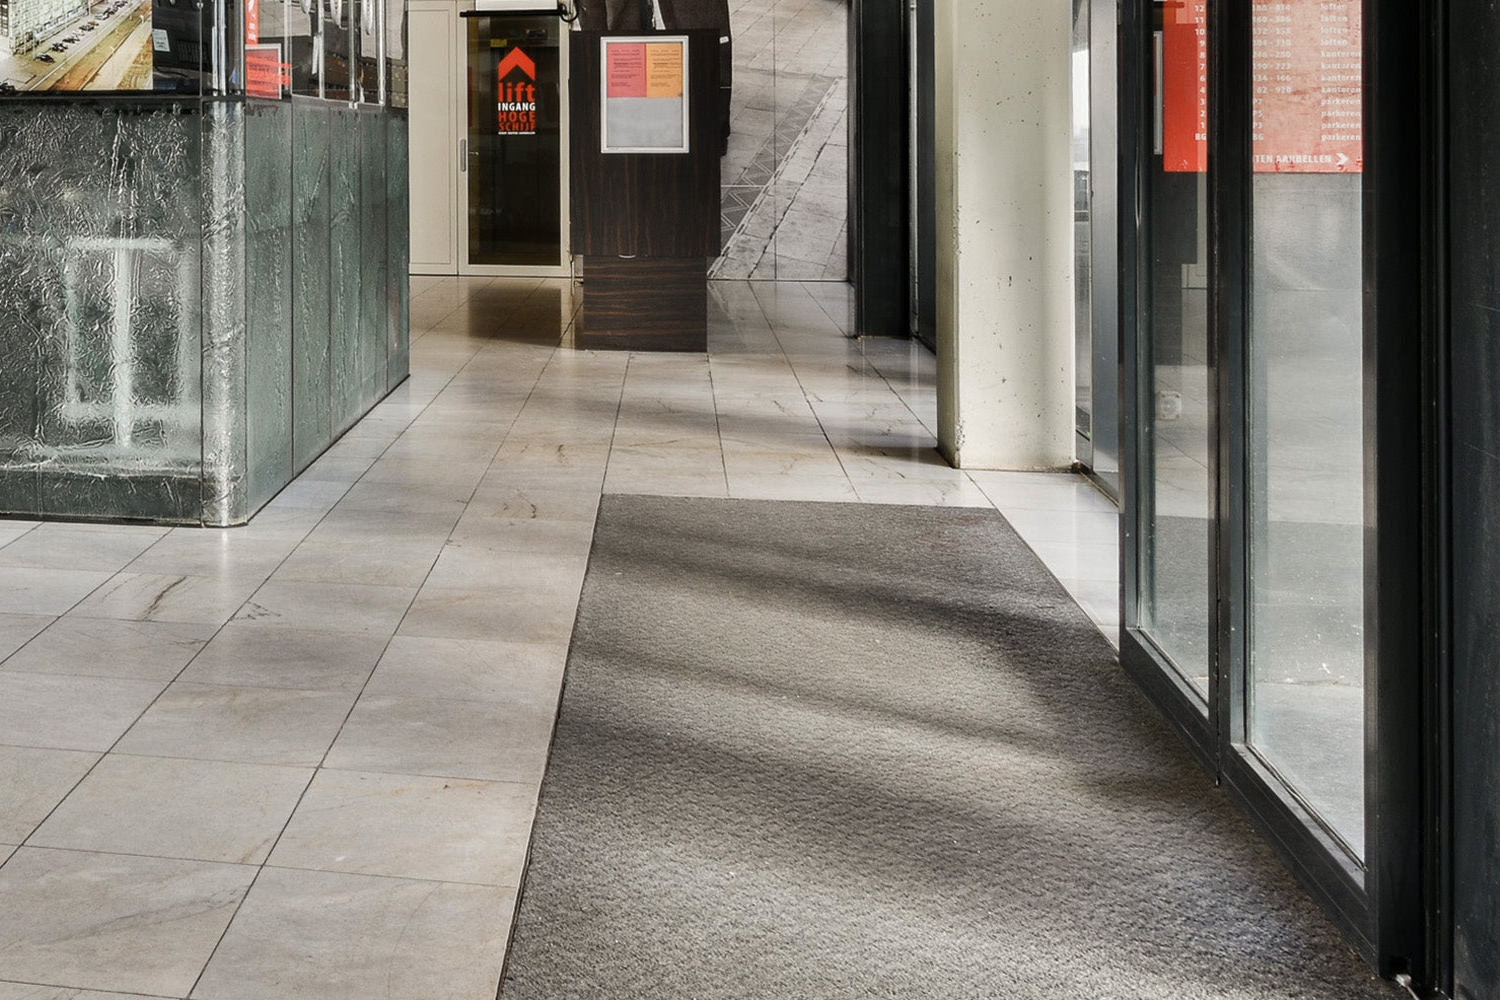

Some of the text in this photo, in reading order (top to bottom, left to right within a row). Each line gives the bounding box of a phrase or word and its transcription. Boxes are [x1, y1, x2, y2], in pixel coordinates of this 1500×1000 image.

[498, 82, 536, 102] lift
[498, 102, 536, 112] INGANG
[499, 111, 536, 122] HOGE
[499, 122, 536, 131] SCHIJF
[1276, 155, 1332, 163] AANBELLEN
